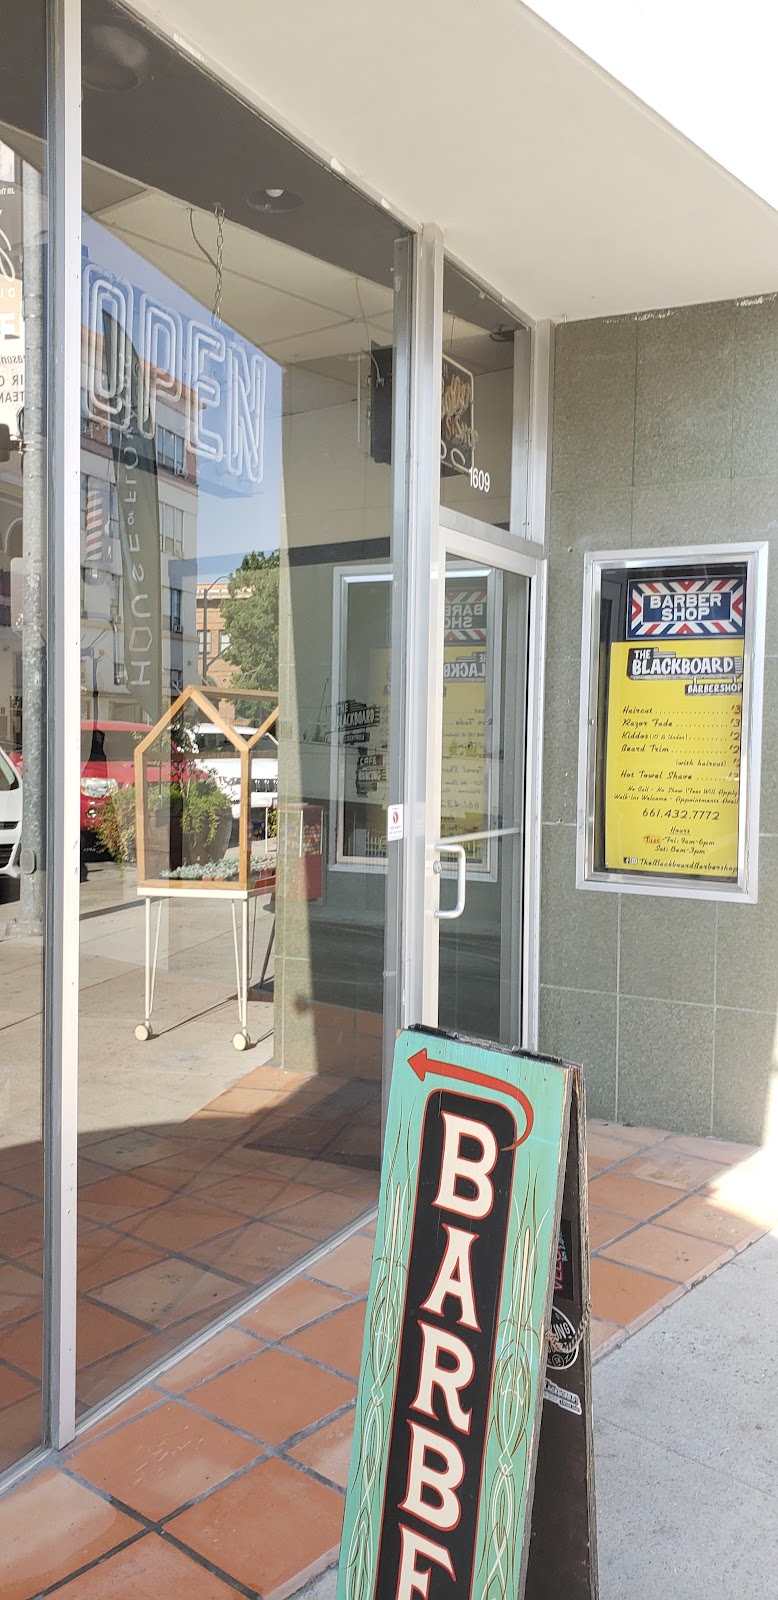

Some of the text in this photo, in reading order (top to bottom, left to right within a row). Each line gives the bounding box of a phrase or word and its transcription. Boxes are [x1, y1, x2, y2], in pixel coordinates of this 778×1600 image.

[81, 263, 267, 484] OPEN
[468, 467, 491, 493] 1609
[650, 593, 722, 609] BARBER
[661, 607, 710, 621] SHOP
[633, 649, 651, 660] THE
[632, 657, 734, 675] BLACKBOARD
[687, 683, 742, 694] BARBERSHOP
[623, 705, 653, 714] Haircut
[622, 718, 648, 729] Razor
[652, 718, 673, 727] Fade
[621, 731, 648, 739] Kiddos
[621, 744, 646, 753] Beard
[649, 744, 669, 753] Trim
[675, 759, 694, 767] (with
[697, 759, 727, 767] haircut)
[620, 770, 634, 778] Hot
[638, 770, 662, 779] Towel
[666, 770, 692, 780] Shave
[638, 785, 649, 793] Call
[703, 787, 715, 795] Will
[675, 796, 719, 804] Appointments
[642, 808, 720, 821] 661.432.7772
[670, 826, 690, 834] Hours
[681, 837, 715, 847] 9am-6pm
